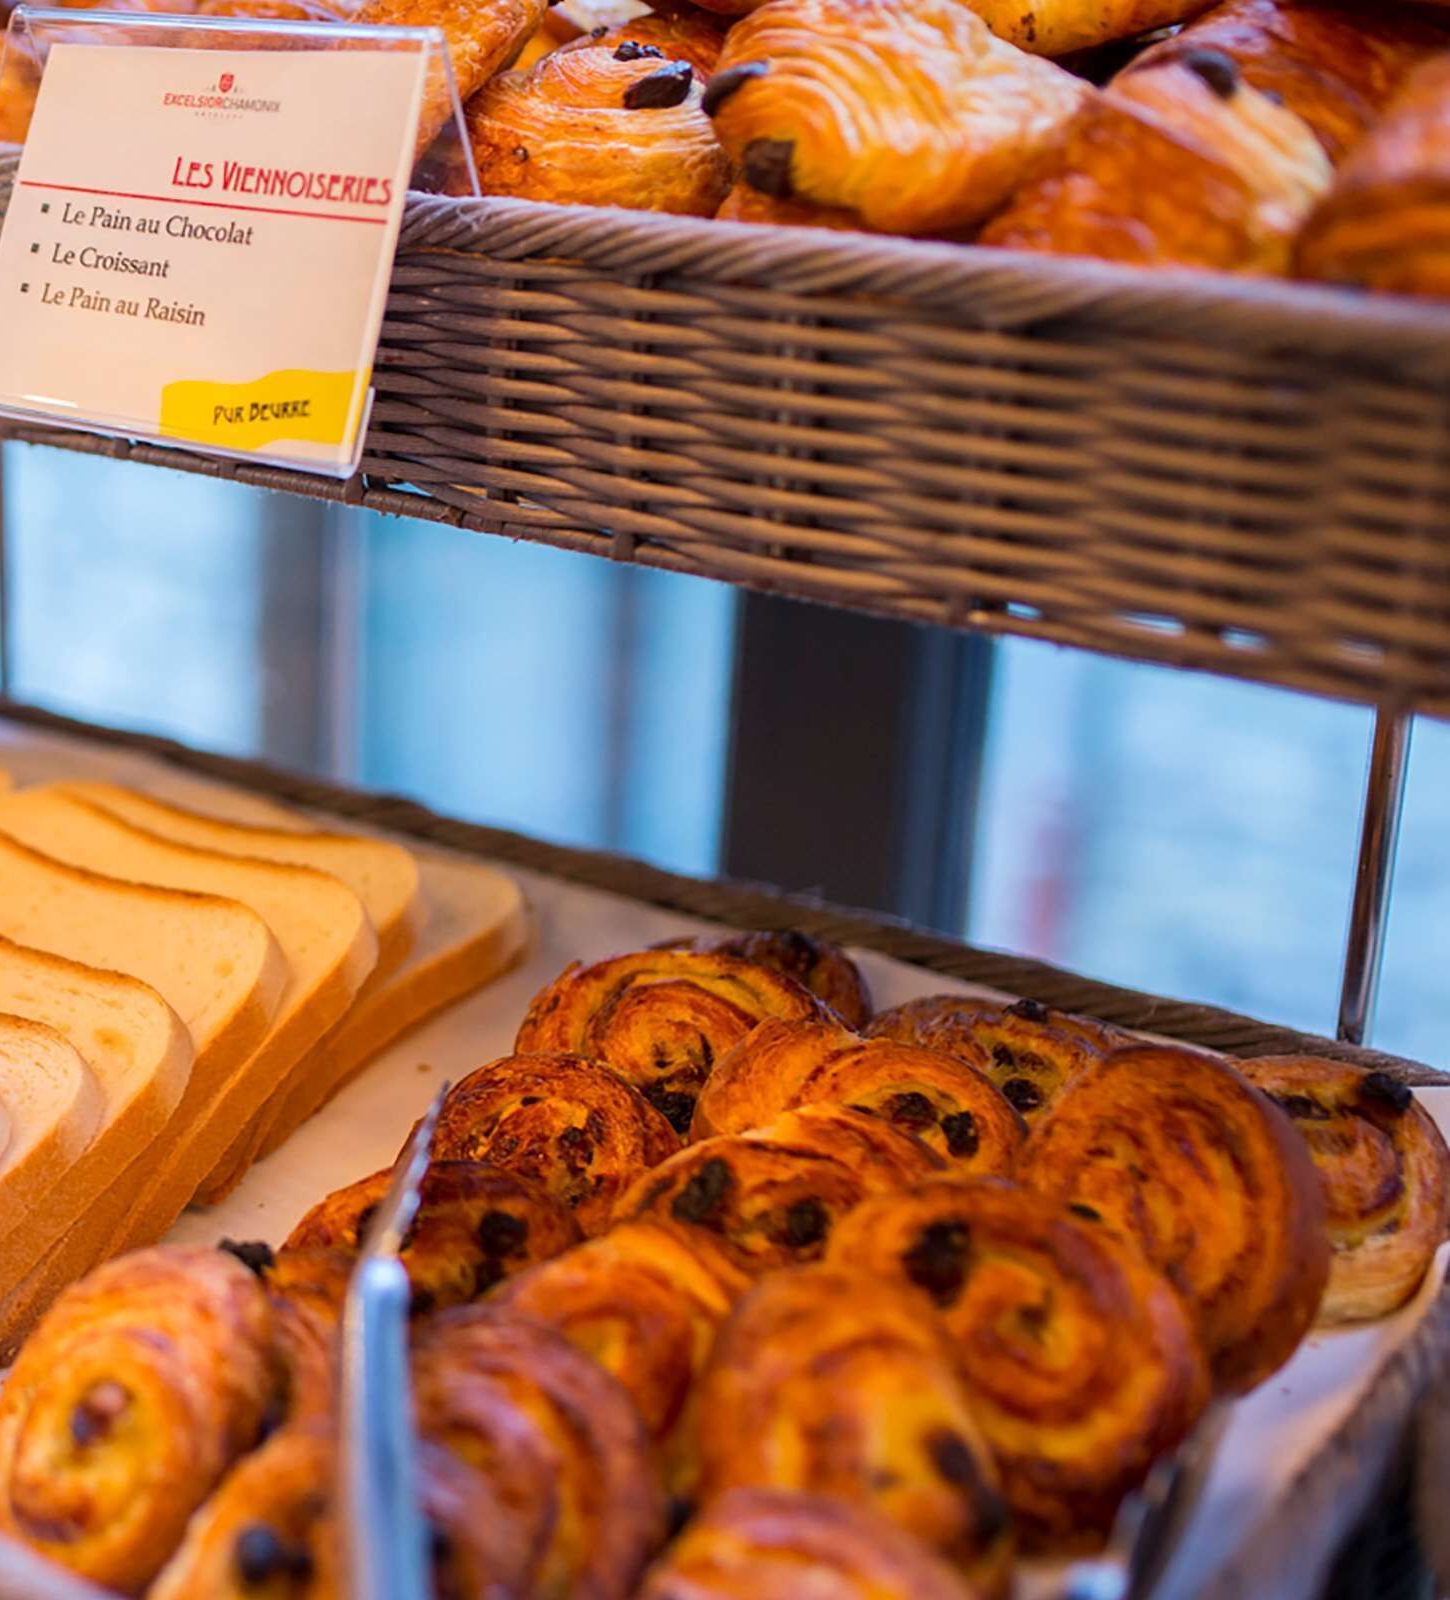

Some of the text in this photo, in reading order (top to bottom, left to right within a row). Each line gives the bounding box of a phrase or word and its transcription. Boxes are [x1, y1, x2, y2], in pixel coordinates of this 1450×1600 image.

[172, 157, 392, 206] LES VIENNOISERIES
[61, 203, 254, 245] Le Pain au Chocolat
[51, 243, 170, 278] Le Croissant
[40, 283, 206, 326] Le Pain au Raisin
[213, 400, 310, 425] PUR BEURRE
